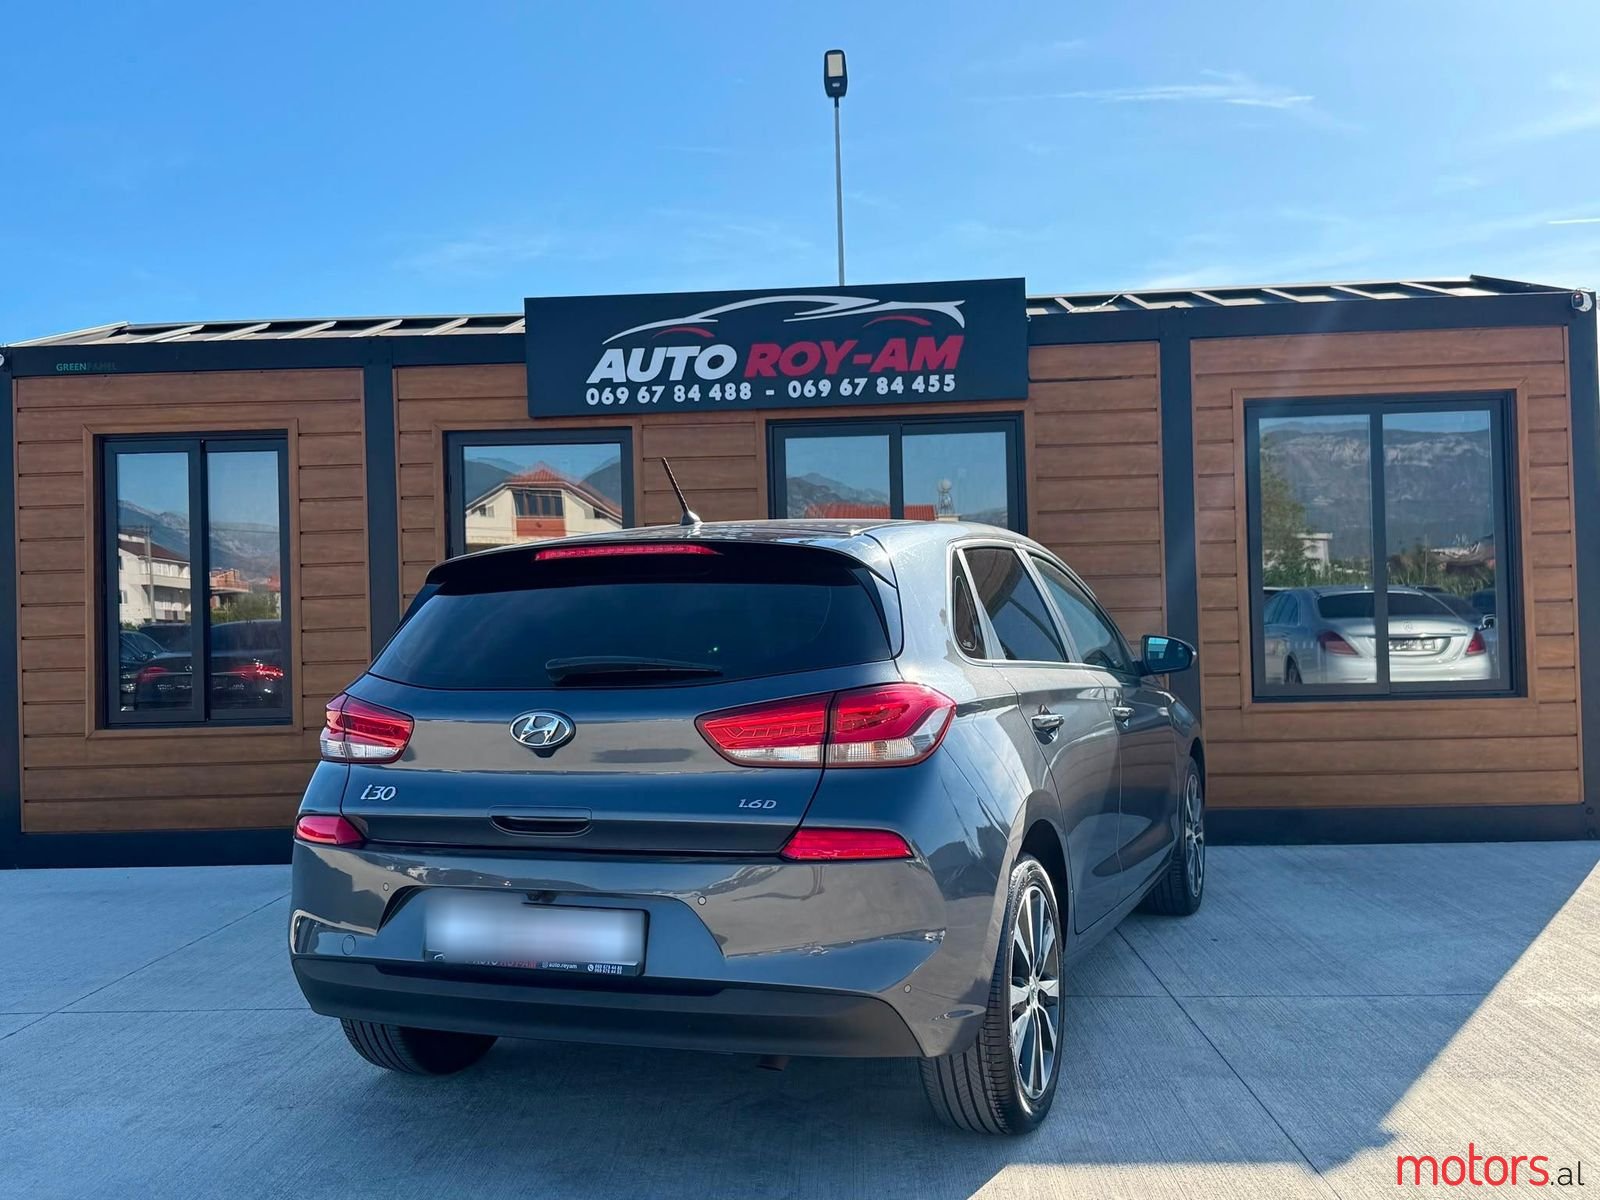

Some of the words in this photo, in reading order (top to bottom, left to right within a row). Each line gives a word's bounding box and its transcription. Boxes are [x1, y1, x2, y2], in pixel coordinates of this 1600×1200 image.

[585, 344, 738, 384] AUTO
[744, 335, 965, 378] ROY-AM
[585, 387, 630, 406] 069
[637, 385, 665, 404] 67
[673, 384, 701, 402] 84
[708, 382, 752, 401] 488
[787, 379, 832, 398] 069
[839, 377, 868, 396] 67
[876, 376, 904, 395] 84
[911, 374, 956, 393] 455
[738, 798, 777, 809] 1.6D
